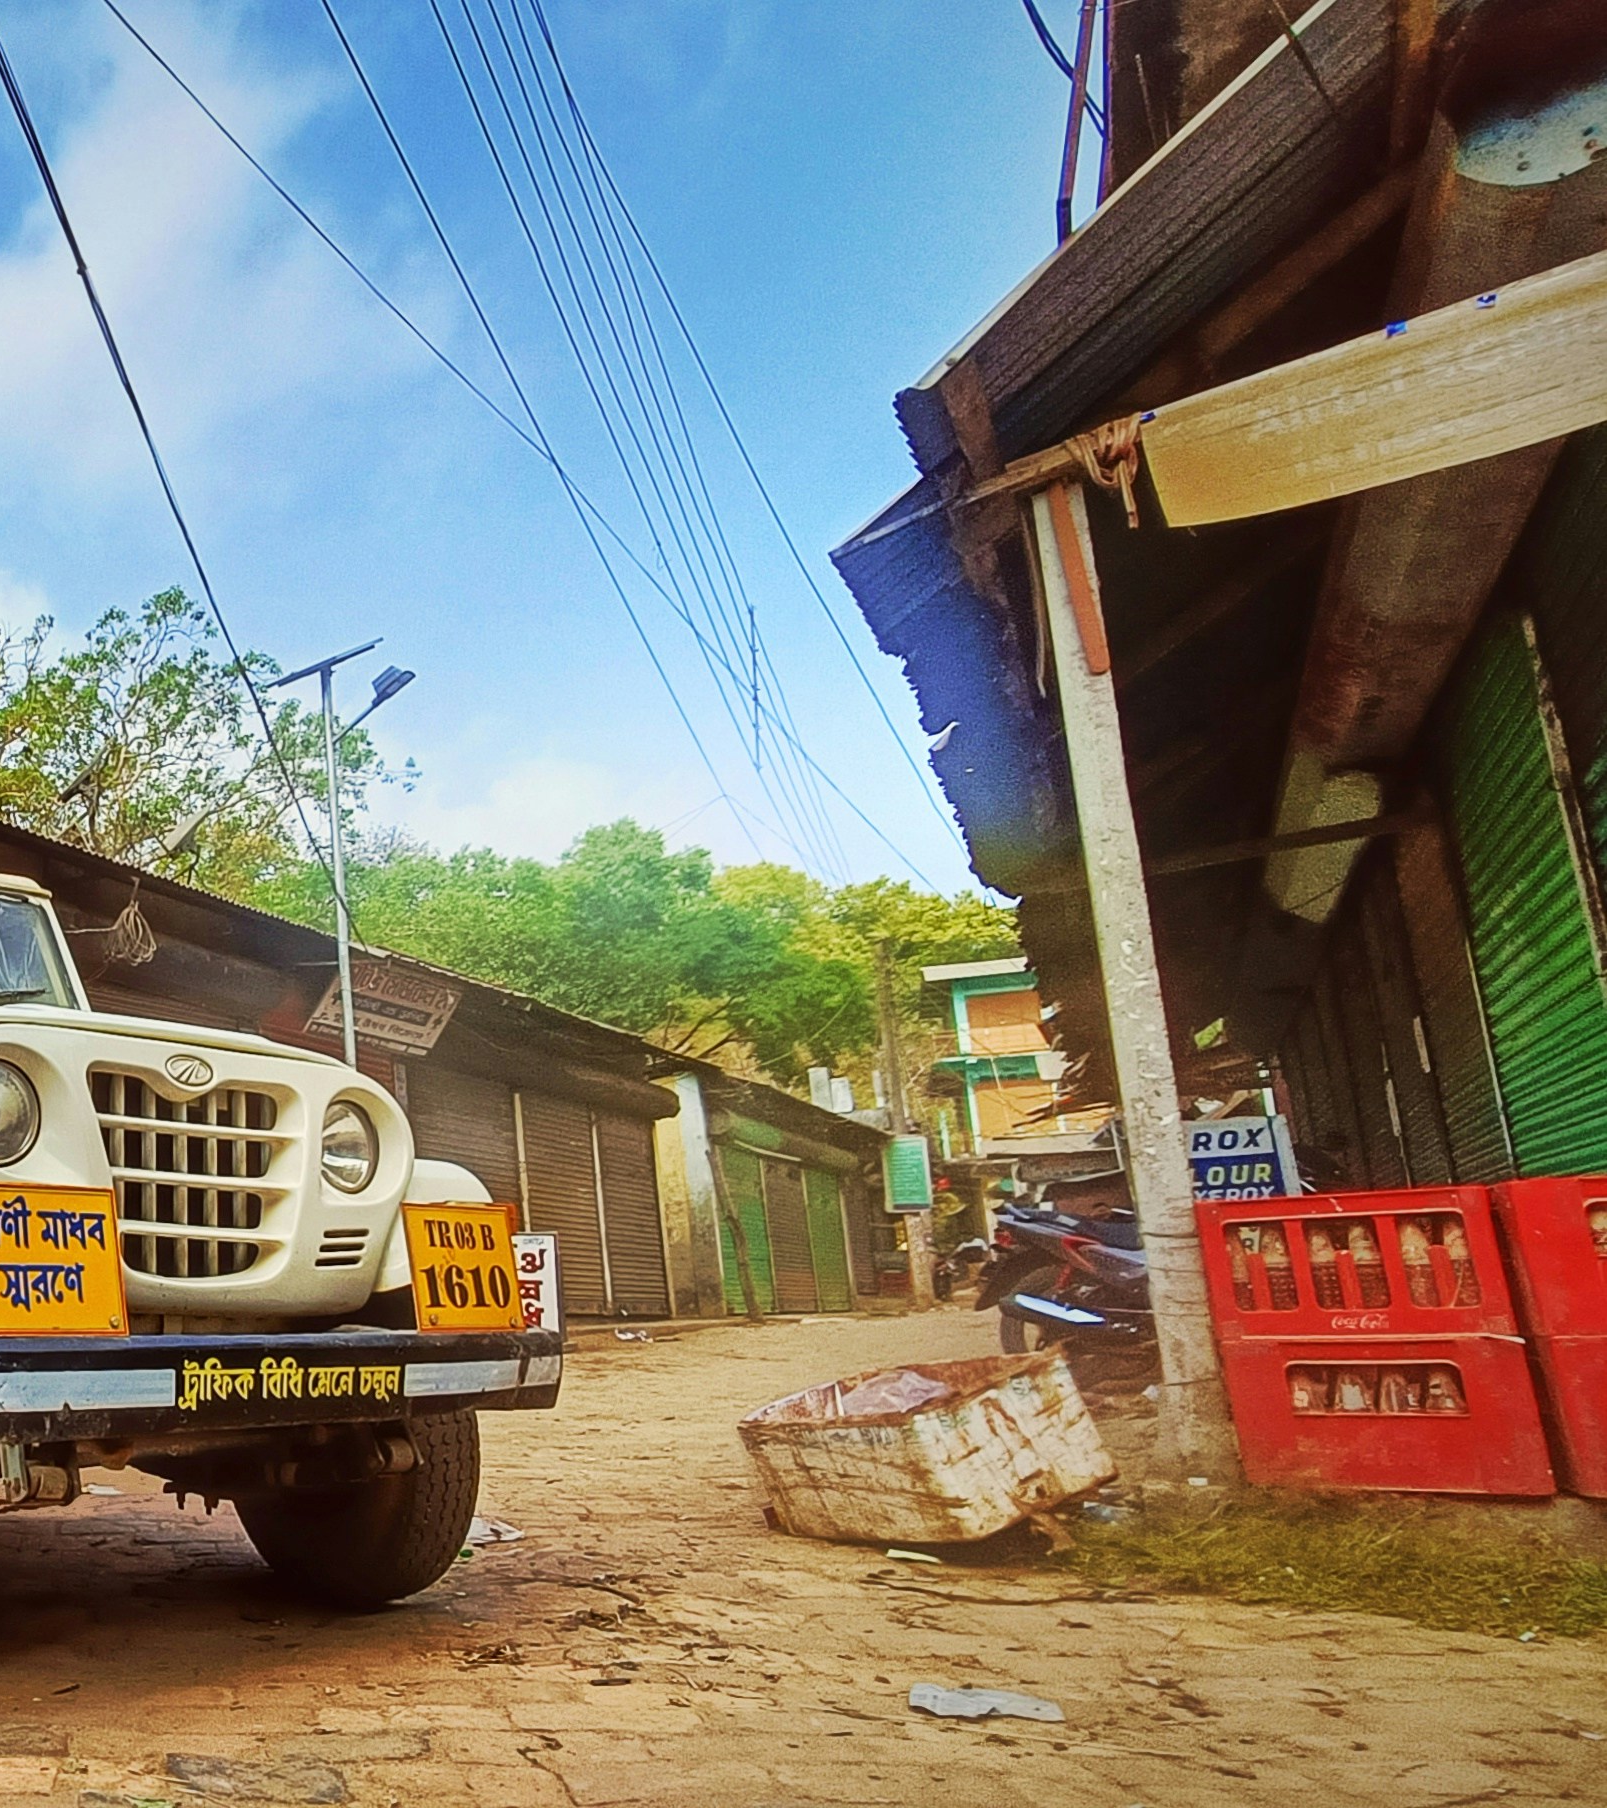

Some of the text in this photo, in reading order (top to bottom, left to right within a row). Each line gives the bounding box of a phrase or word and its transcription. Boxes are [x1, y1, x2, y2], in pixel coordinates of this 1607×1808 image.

[36, 1209, 107, 1250] মাধব
[479, 1224, 495, 1251] B
[419, 1264, 511, 1309] 1610
[178, 1356, 402, 1411] ট্রাফিক বিধি মেনে চলুন
